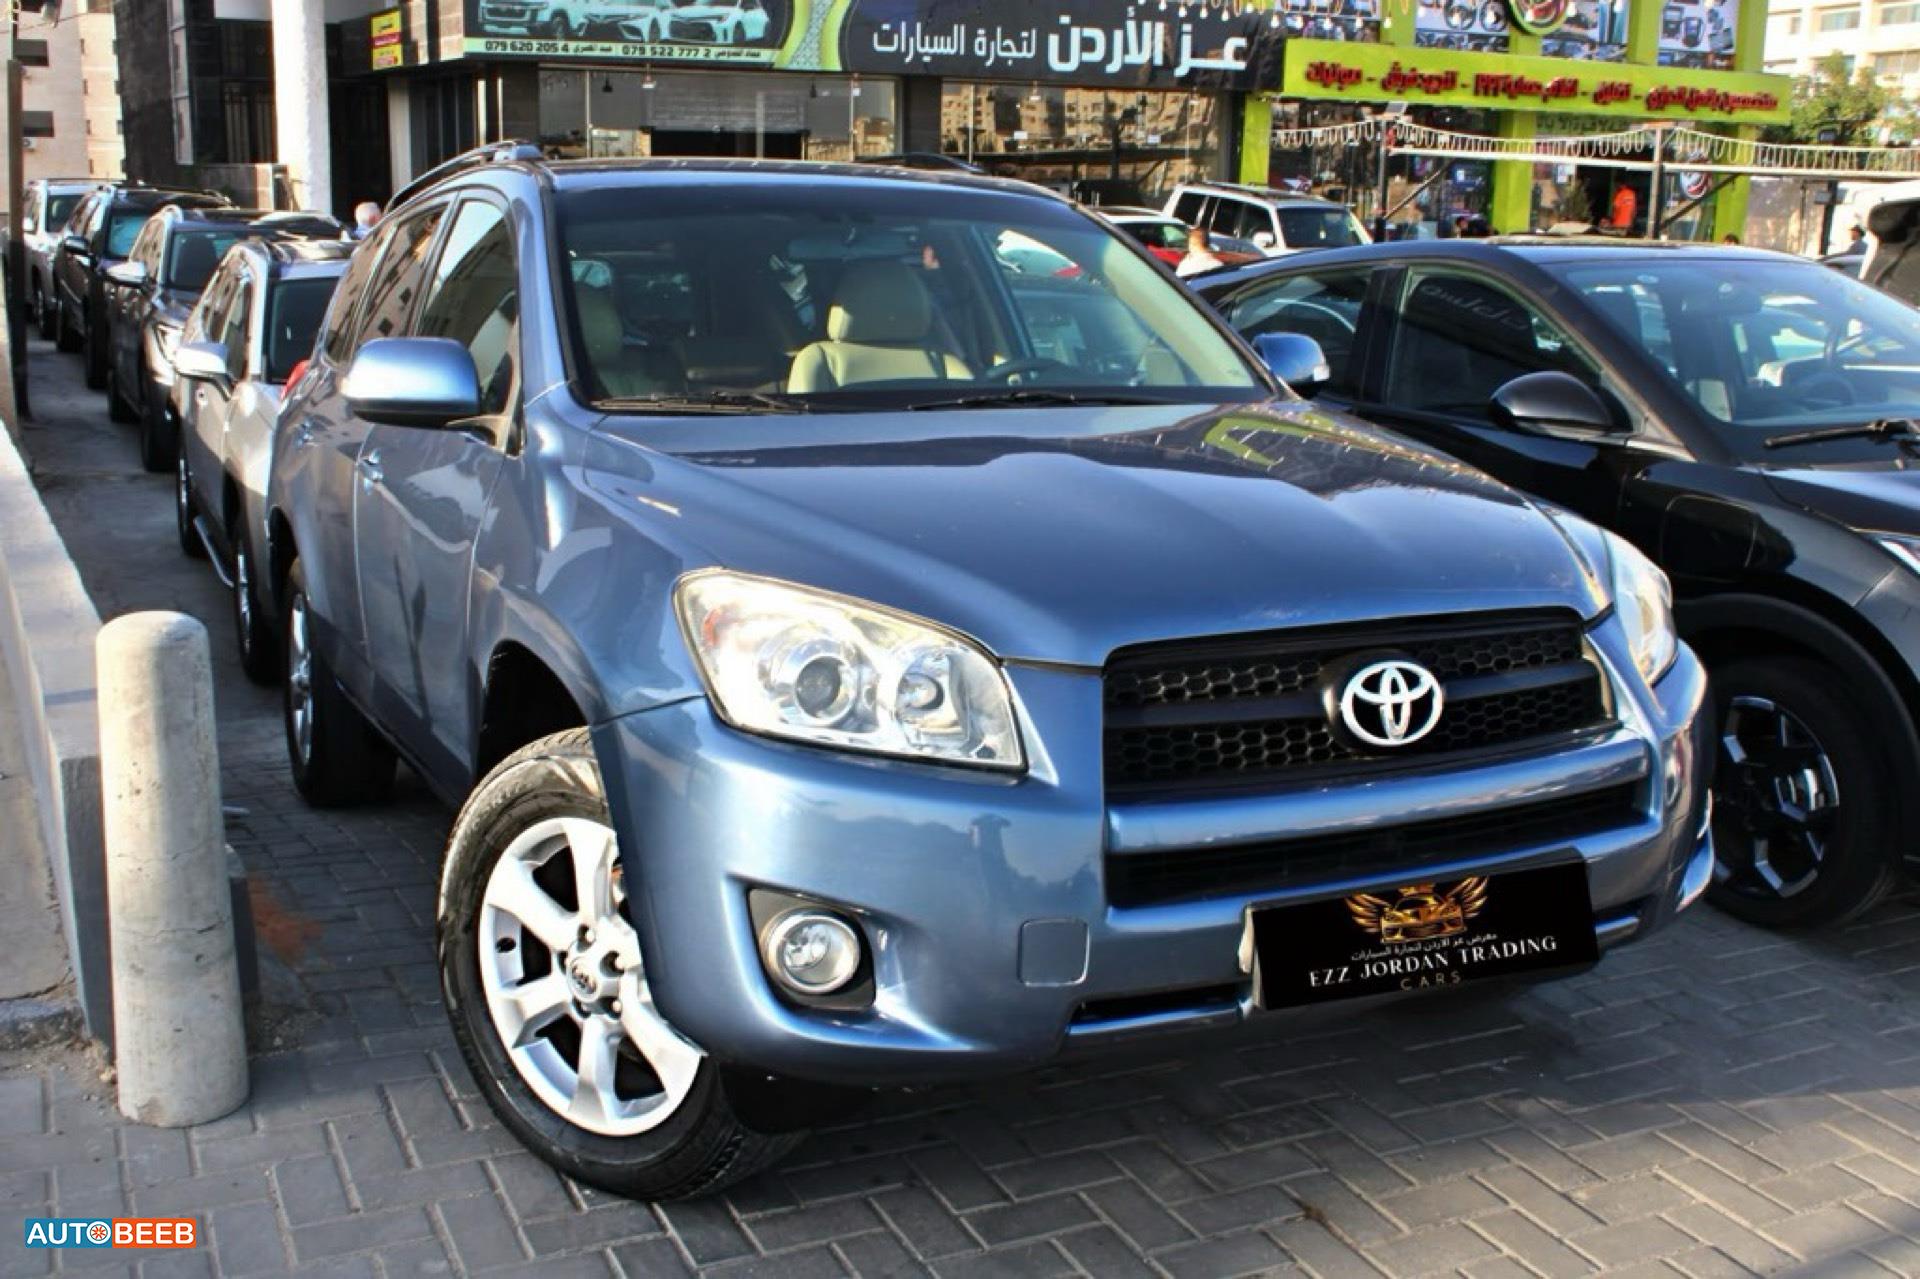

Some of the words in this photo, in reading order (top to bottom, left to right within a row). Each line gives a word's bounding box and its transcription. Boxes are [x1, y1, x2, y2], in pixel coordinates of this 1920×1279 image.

[873, 21, 966, 63] السيارات
[973, 27, 1037, 66] لتجارة
[1047, 5, 1165, 72] الأردن
